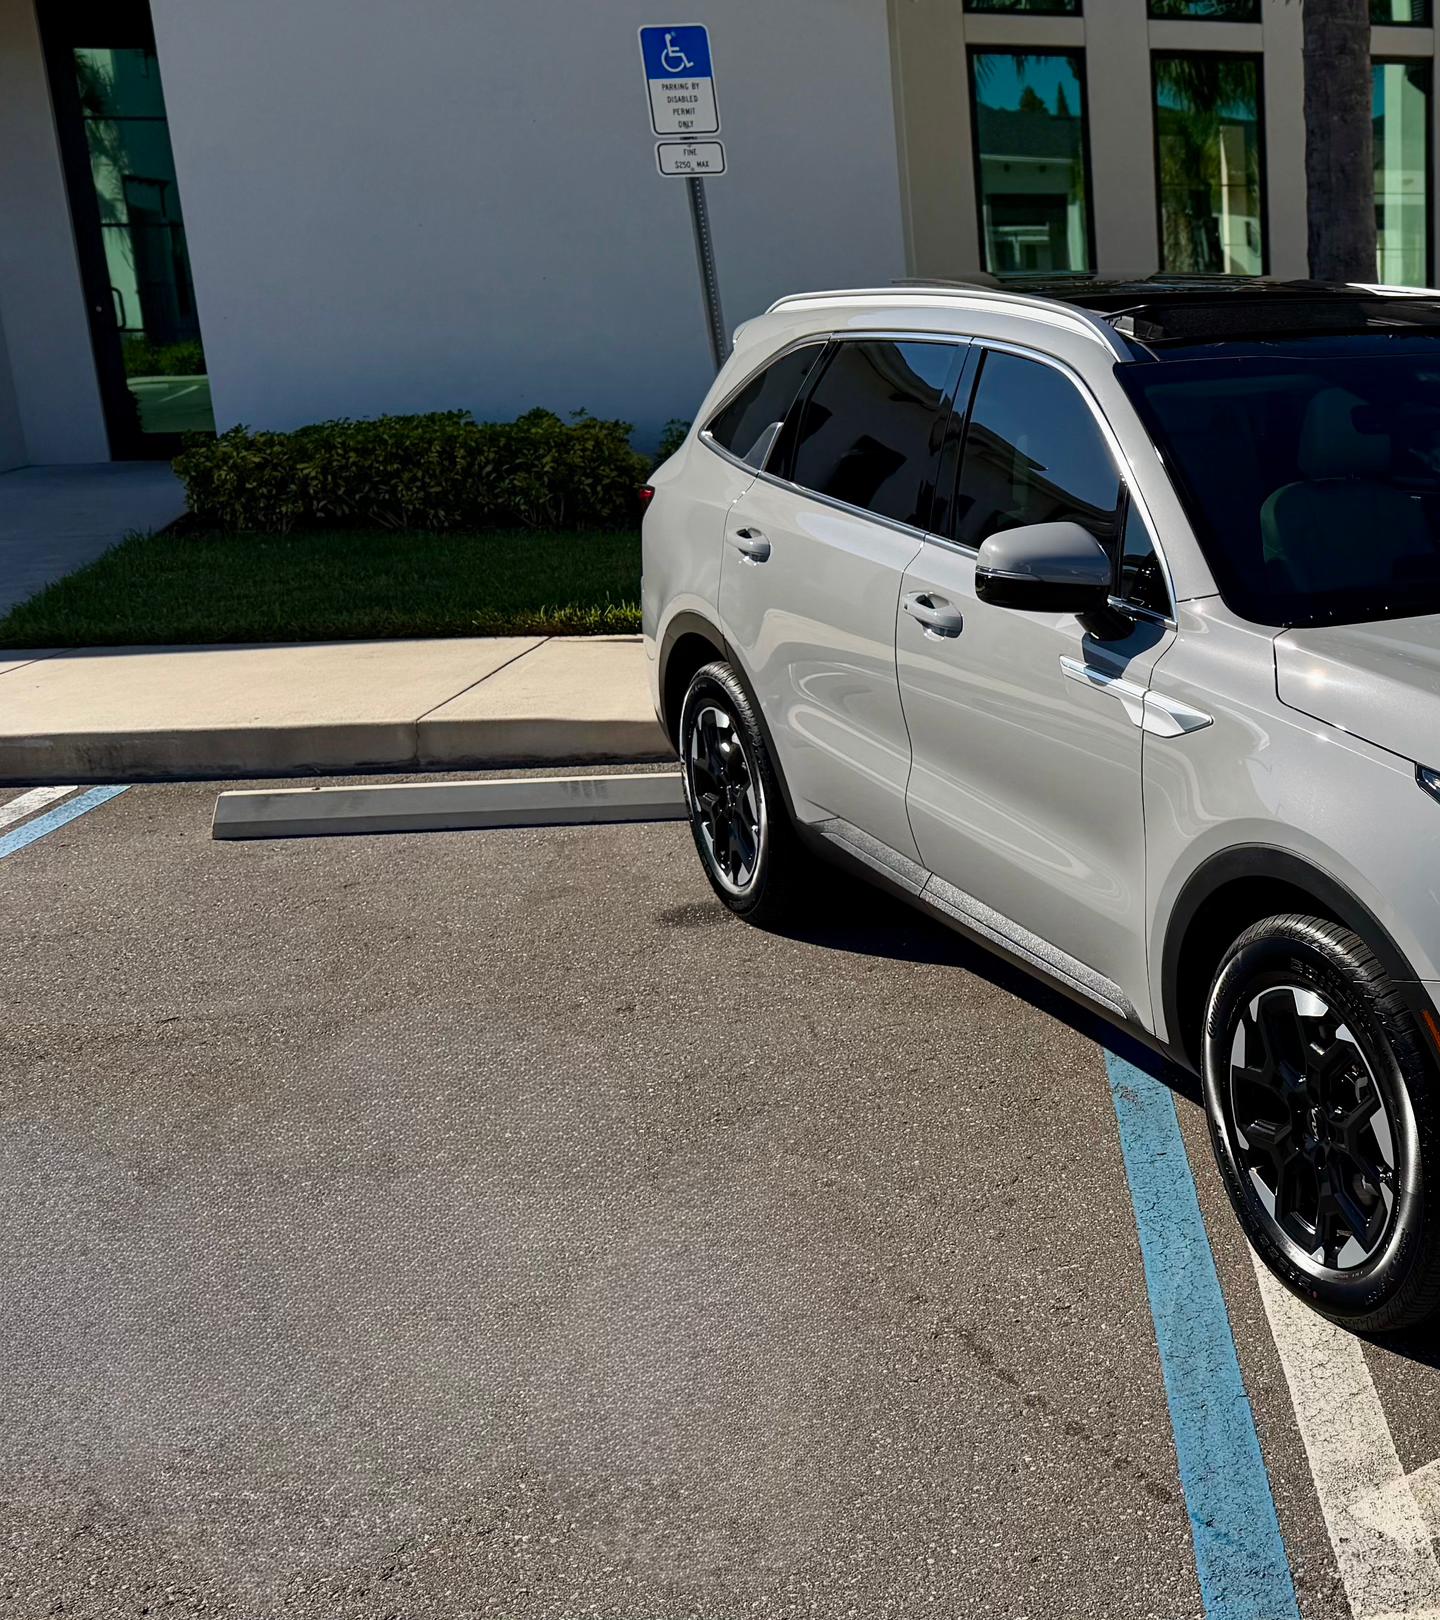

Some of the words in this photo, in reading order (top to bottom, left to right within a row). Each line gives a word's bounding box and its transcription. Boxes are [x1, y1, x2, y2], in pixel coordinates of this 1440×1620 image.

[661, 83, 689, 91] PARKING
[691, 82, 699, 90] BY
[667, 95, 698, 103] DISABLED
[672, 107, 695, 116] PERMIT
[678, 120, 694, 129] ONLY
[683, 148, 697, 156] FINE
